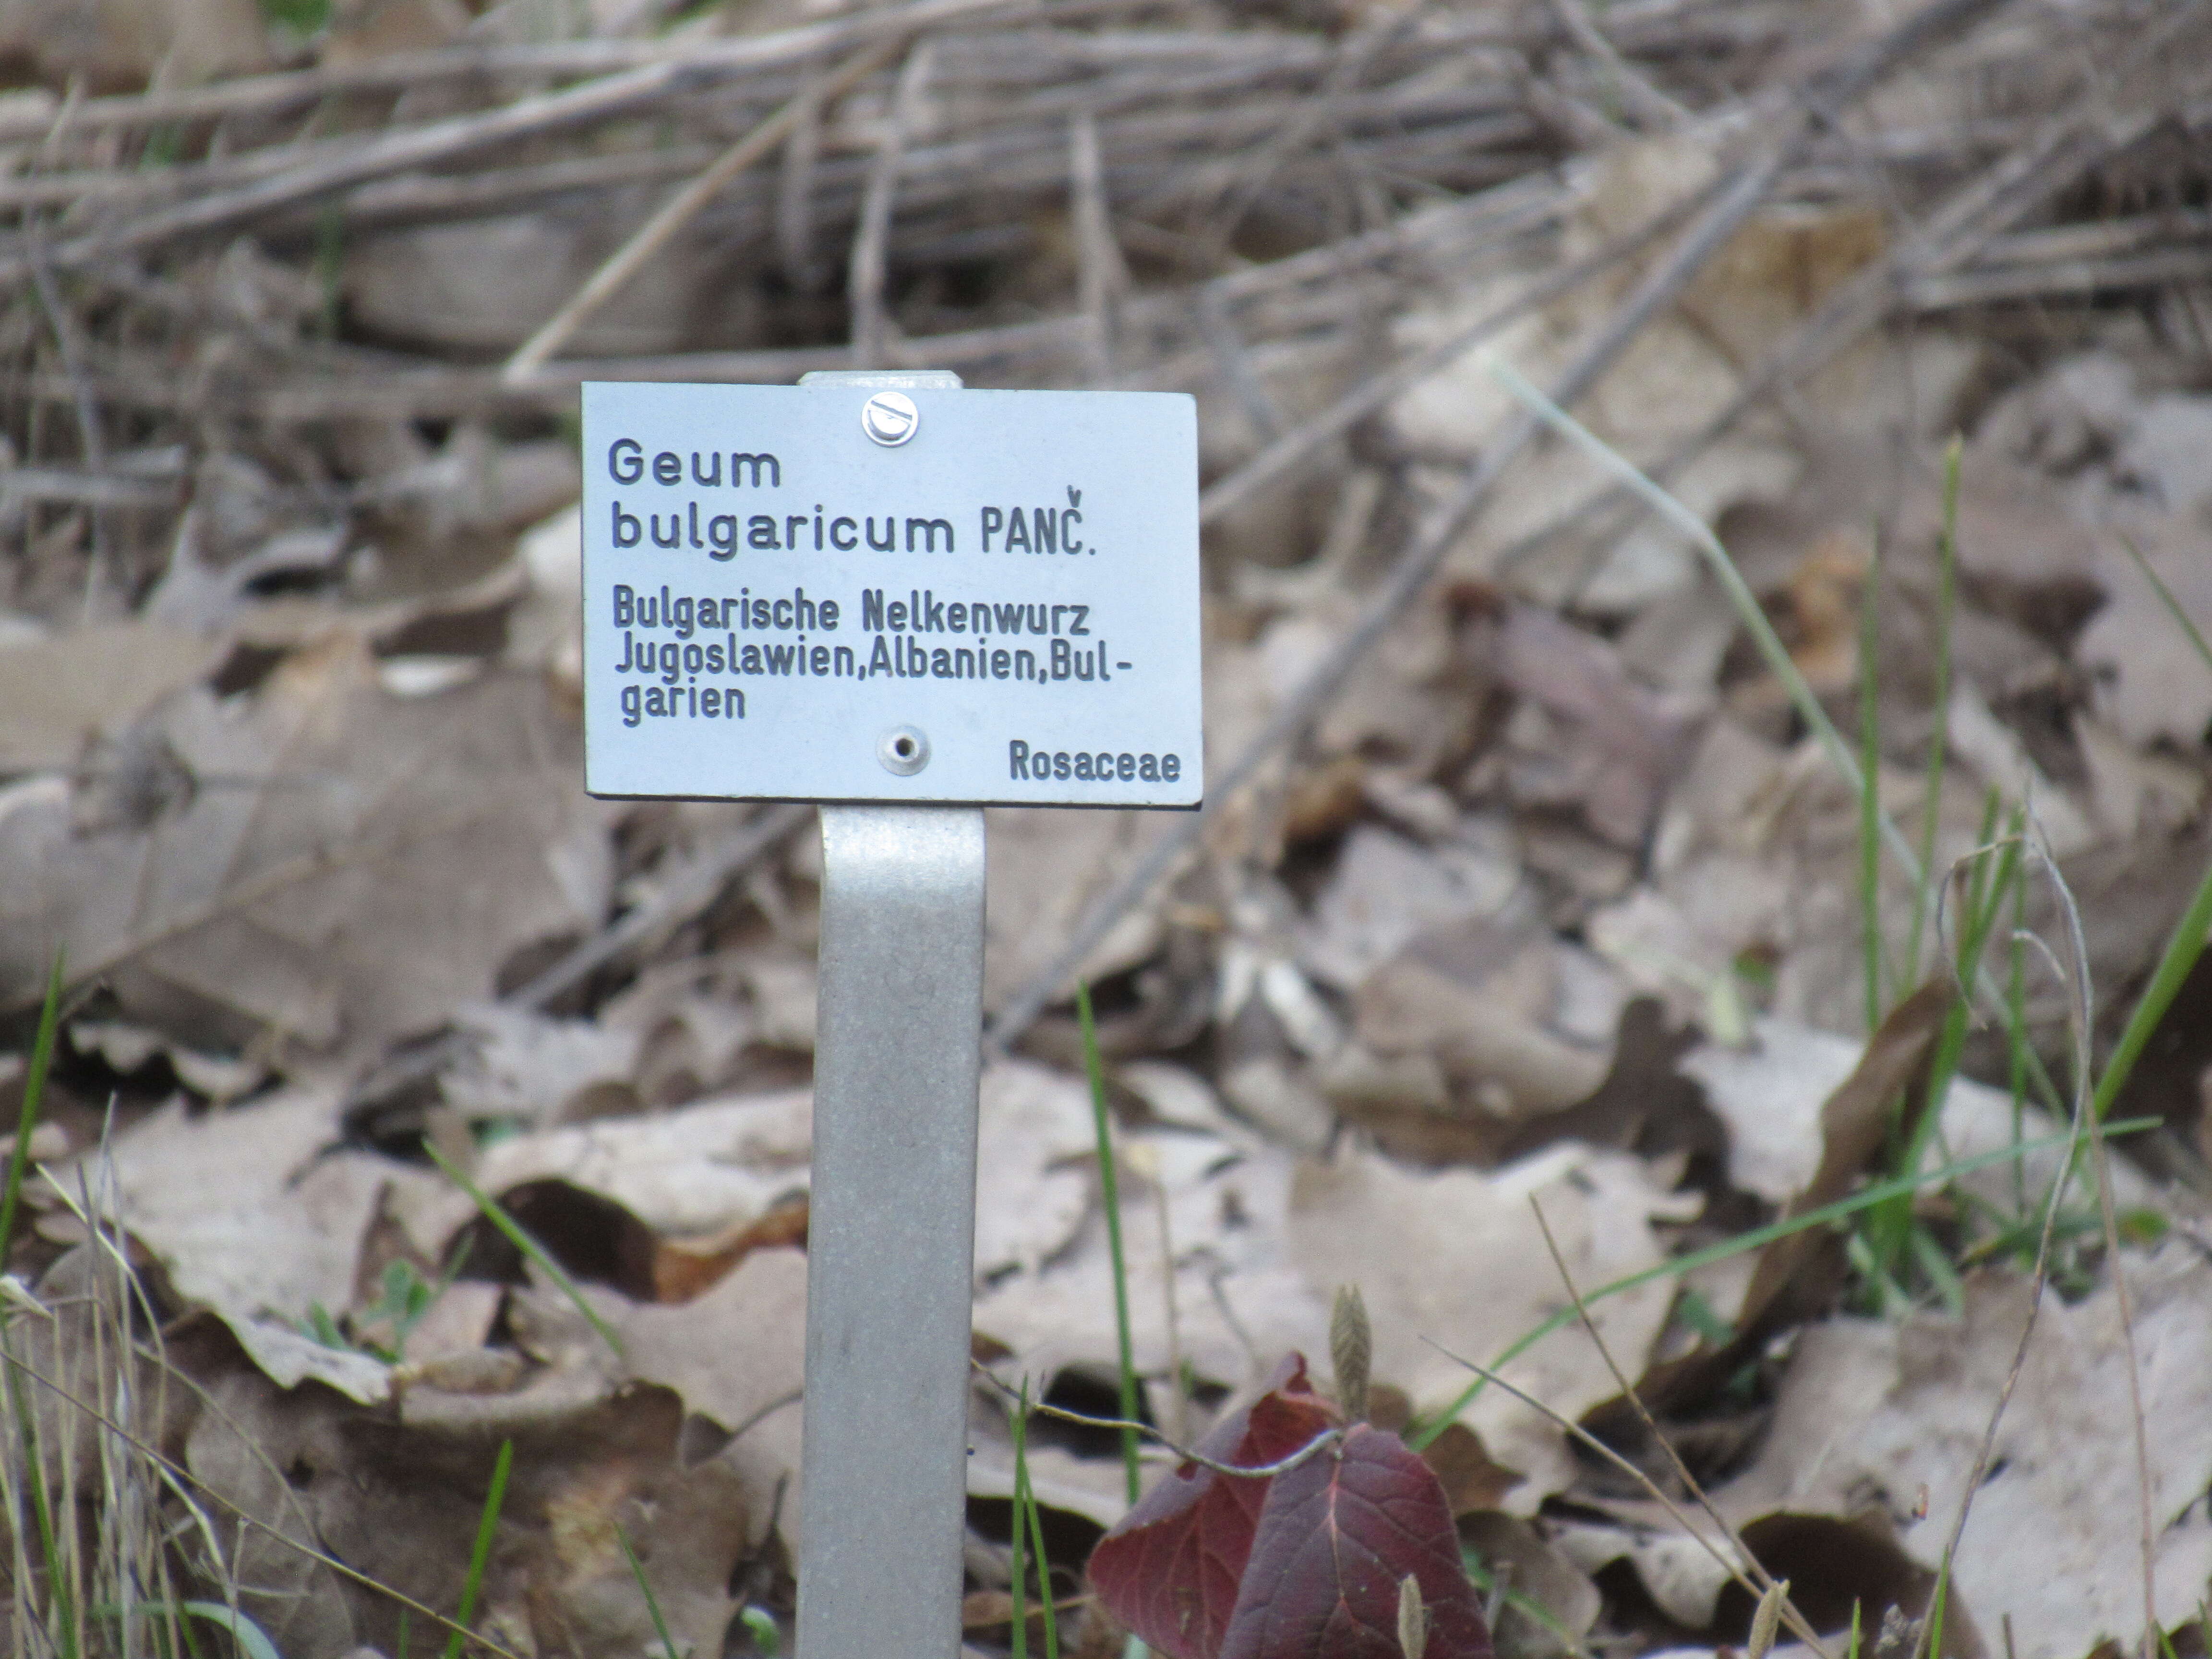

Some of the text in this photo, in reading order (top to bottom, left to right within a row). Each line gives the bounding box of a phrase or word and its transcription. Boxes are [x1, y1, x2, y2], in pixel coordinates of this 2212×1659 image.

[608, 437, 781, 488] Geum
[611, 484, 1096, 563] bulgaricum PANČ.
[613, 584, 1090, 640] Bulgarische Nelkenwurz
[621, 676, 746, 728] garien
[1009, 739, 1181, 783] Rosaceae
